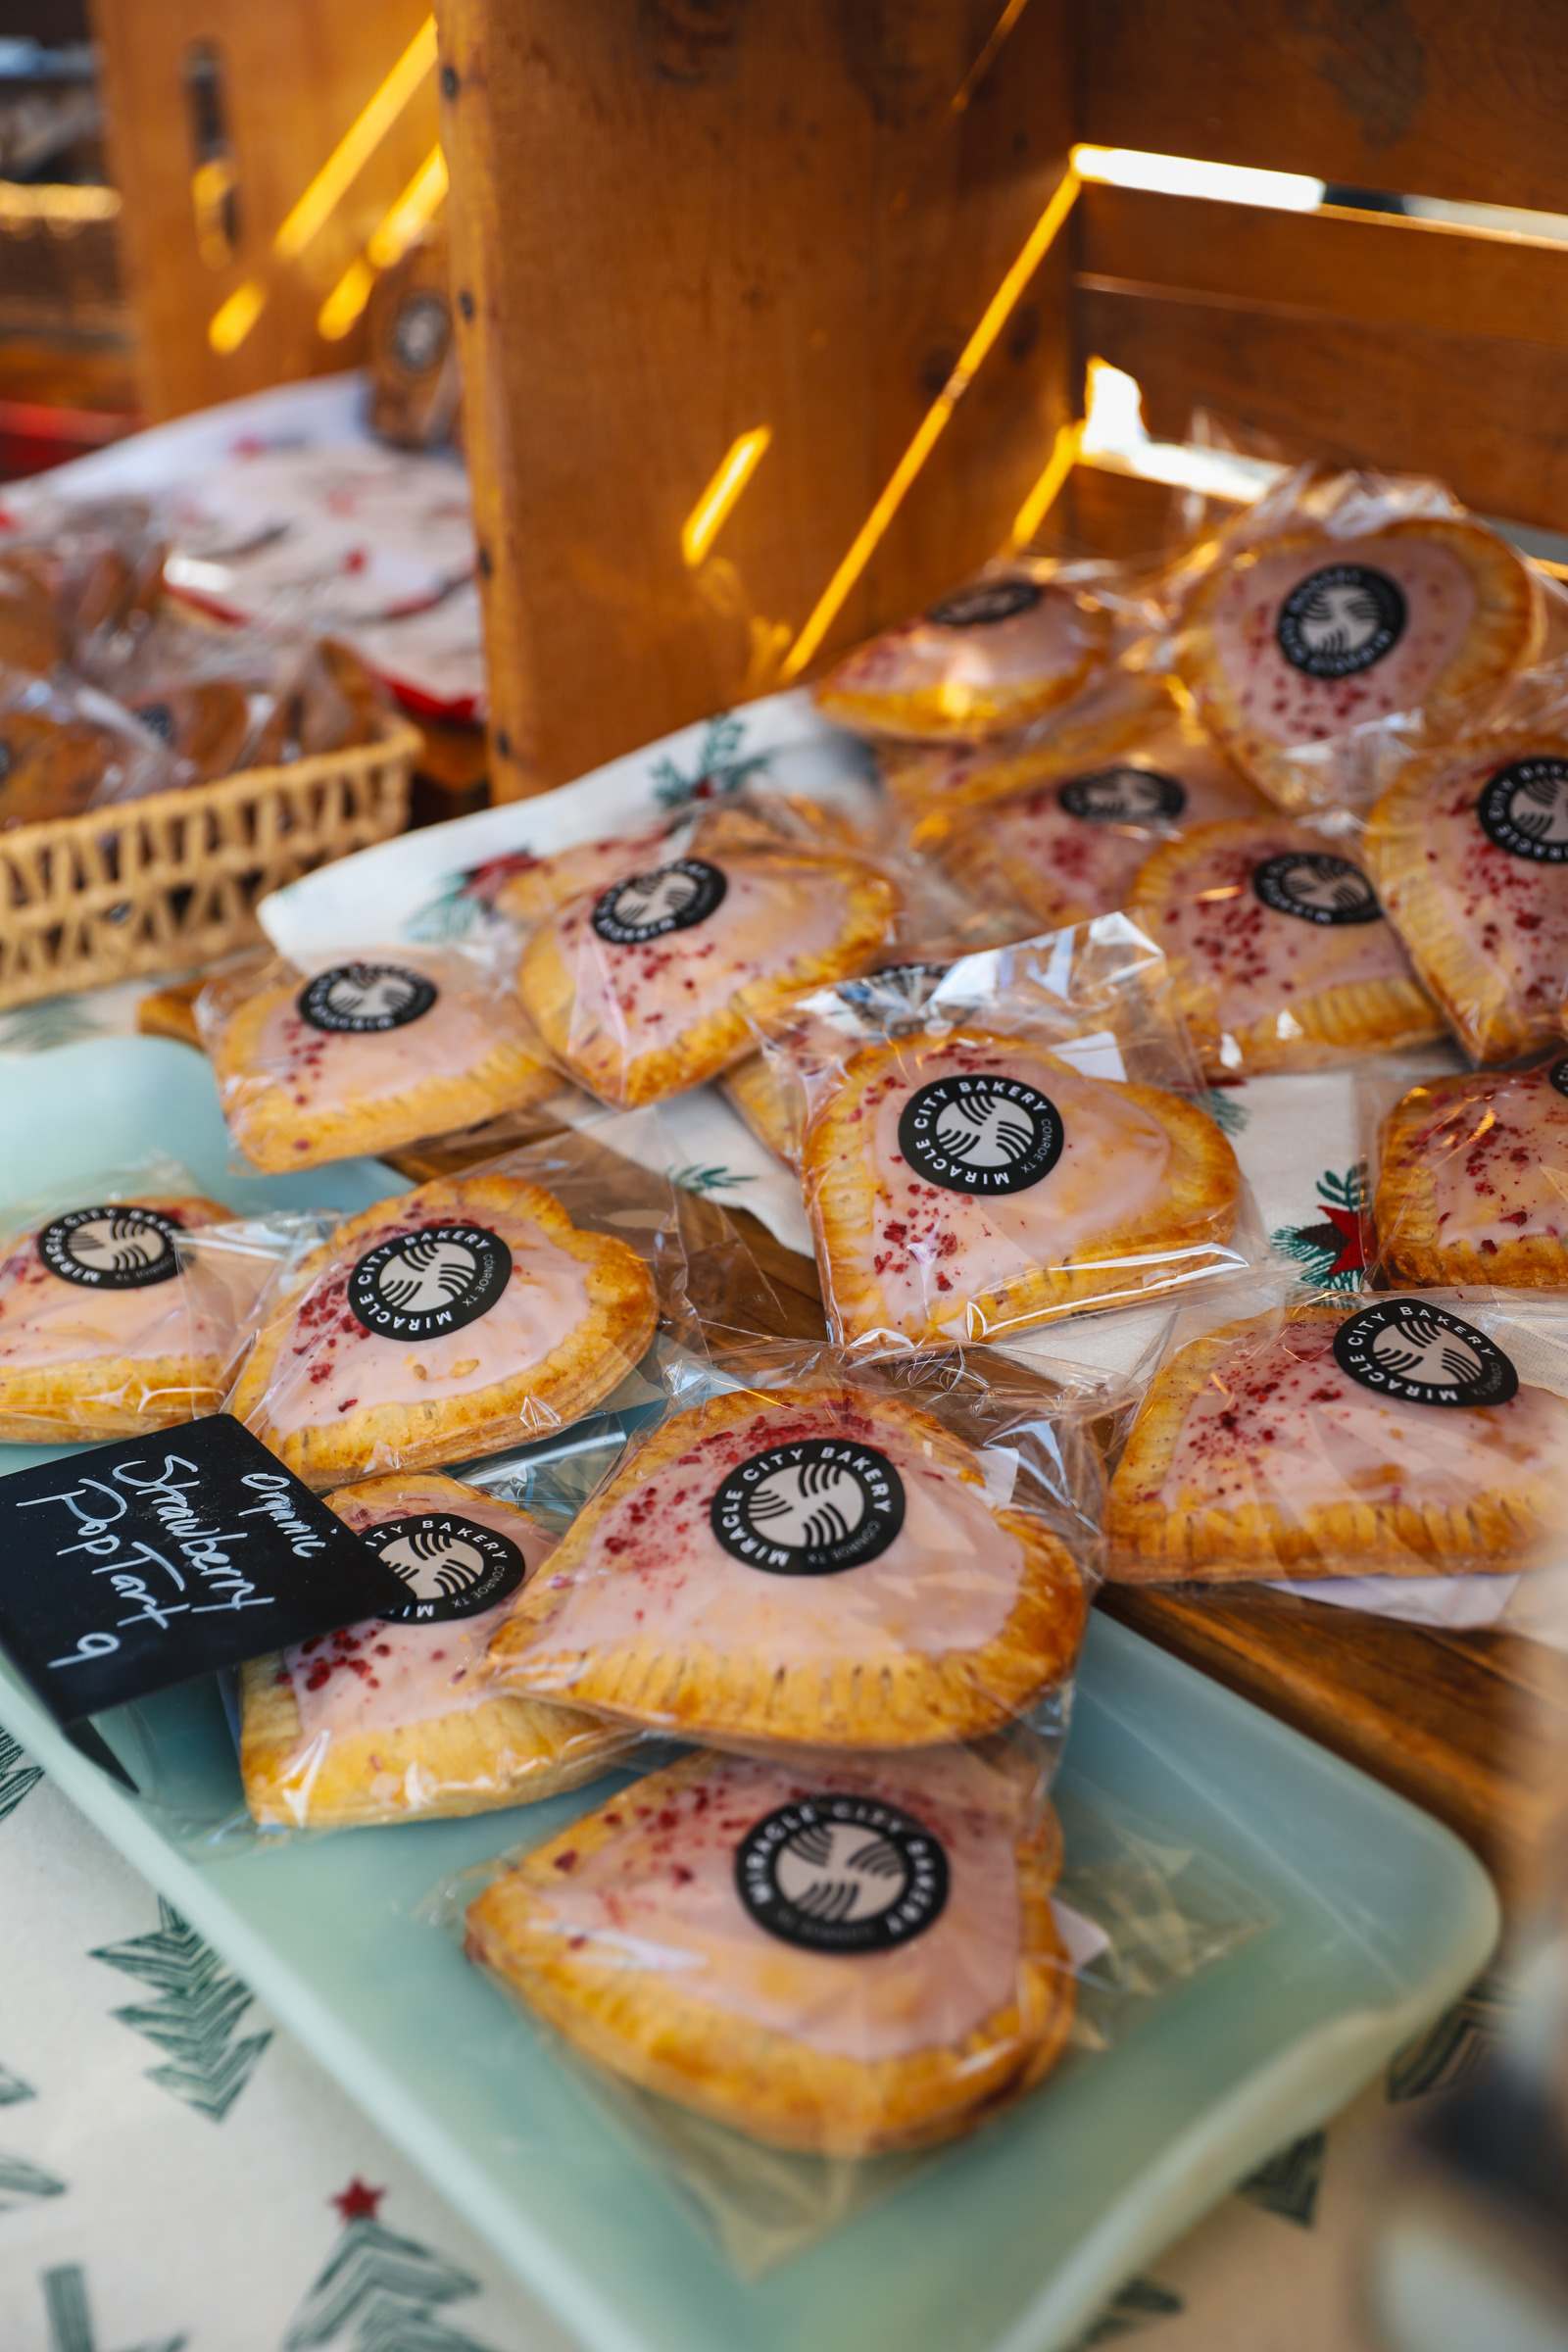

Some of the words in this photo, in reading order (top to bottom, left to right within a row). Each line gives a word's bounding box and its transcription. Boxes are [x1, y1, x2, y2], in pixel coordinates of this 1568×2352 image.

[914, 1088, 948, 1129] CITY
[958, 1080, 1048, 1111] BAKERY
[1033, 1118, 1054, 1161] CONROE
[915, 1139, 1010, 1185] MIRACLE
[1020, 1161, 1037, 1174] TX
[404, 1230, 490, 1250] BAKERY
[358, 1247, 392, 1286] CITY
[474, 1253, 496, 1293] CONROE
[359, 1293, 453, 1331] MIRACLE
[463, 1294, 478, 1306] TX
[1348, 1312, 1386, 1347] CITY
[1398, 1306, 1495, 1357] BAKERY
[1348, 1353, 1458, 1401] MIRACLE
[743, 1448, 804, 1481] CITY
[820, 1446, 892, 1514] BAKERY
[112, 1454, 276, 1615] Strawberry
[365, 1525, 403, 1547] ITY
[421, 1520, 508, 1559] BAKERY
[721, 1489, 790, 1567] MIRACLE
[47, 1632, 121, 1668] 9
[745, 1804, 817, 1905] MIRACLE
